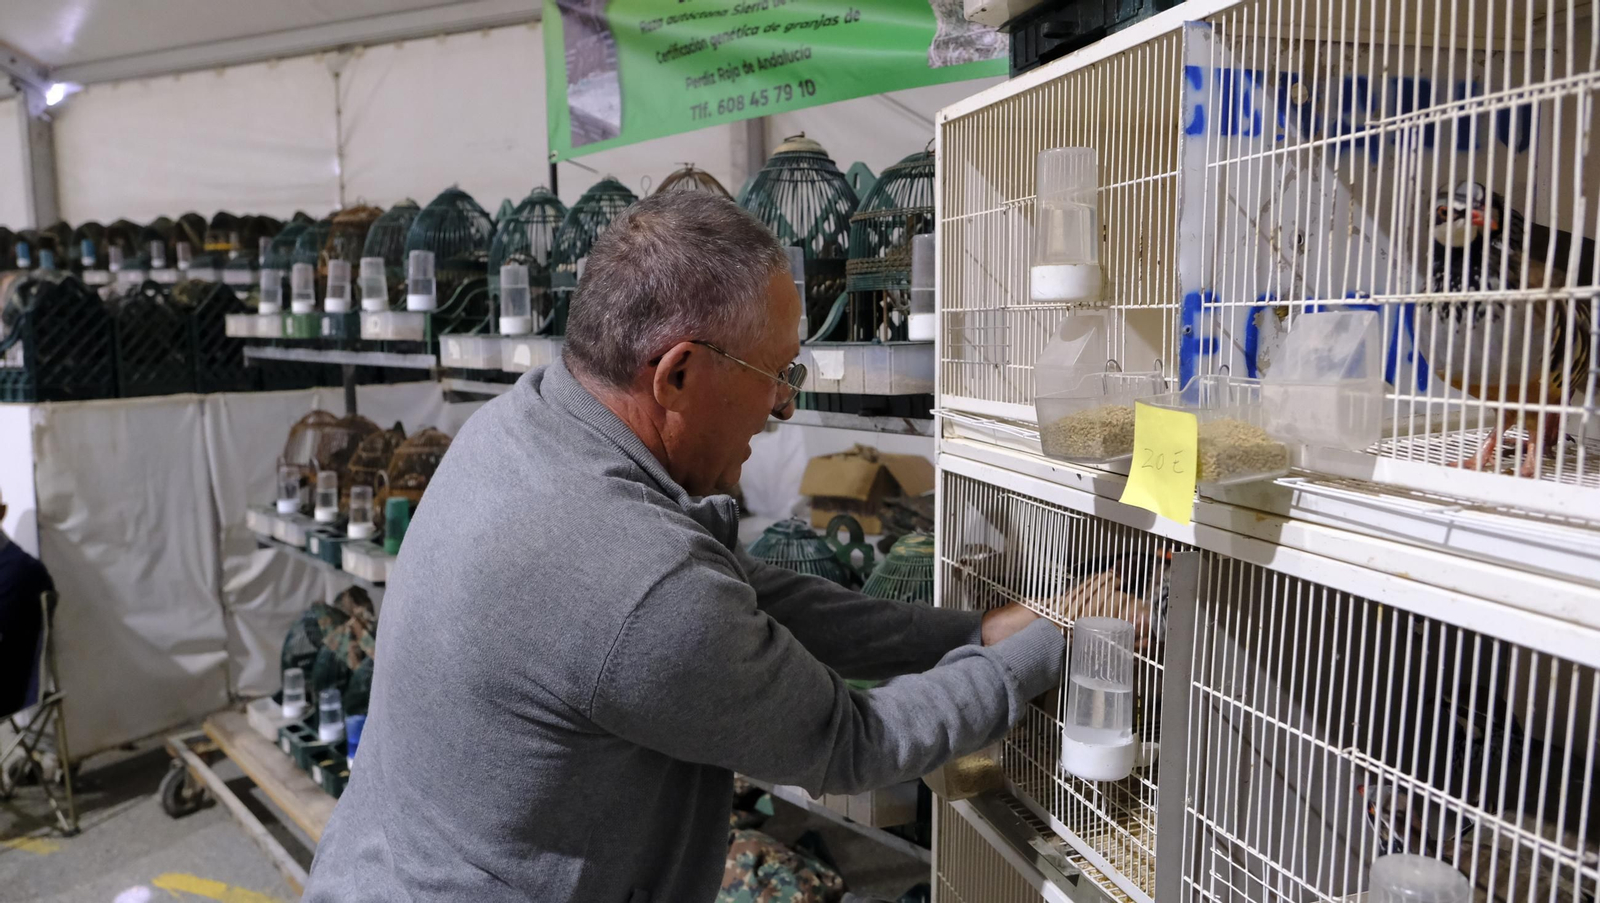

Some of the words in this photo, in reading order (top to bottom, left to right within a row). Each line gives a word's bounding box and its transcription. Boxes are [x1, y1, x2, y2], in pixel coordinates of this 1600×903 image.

[731, 0, 769, 16] Sierra
[656, 37, 708, 64] Certificación
[710, 24, 760, 50] genética
[763, 22, 781, 34] de
[783, 14, 840, 33] granjas
[844, 7, 861, 24] de
[685, 70, 716, 90] Perdiz
[717, 62, 741, 83] Roja
[742, 60, 756, 75] de
[757, 43, 812, 71] Andalucía
[690, 102, 712, 121] Tlf.
[717, 95, 745, 115] 608
[749, 89, 769, 107] 45
[773, 84, 793, 103] 79
[797, 79, 816, 97] 10
[1141, 448, 1165, 470] 20
